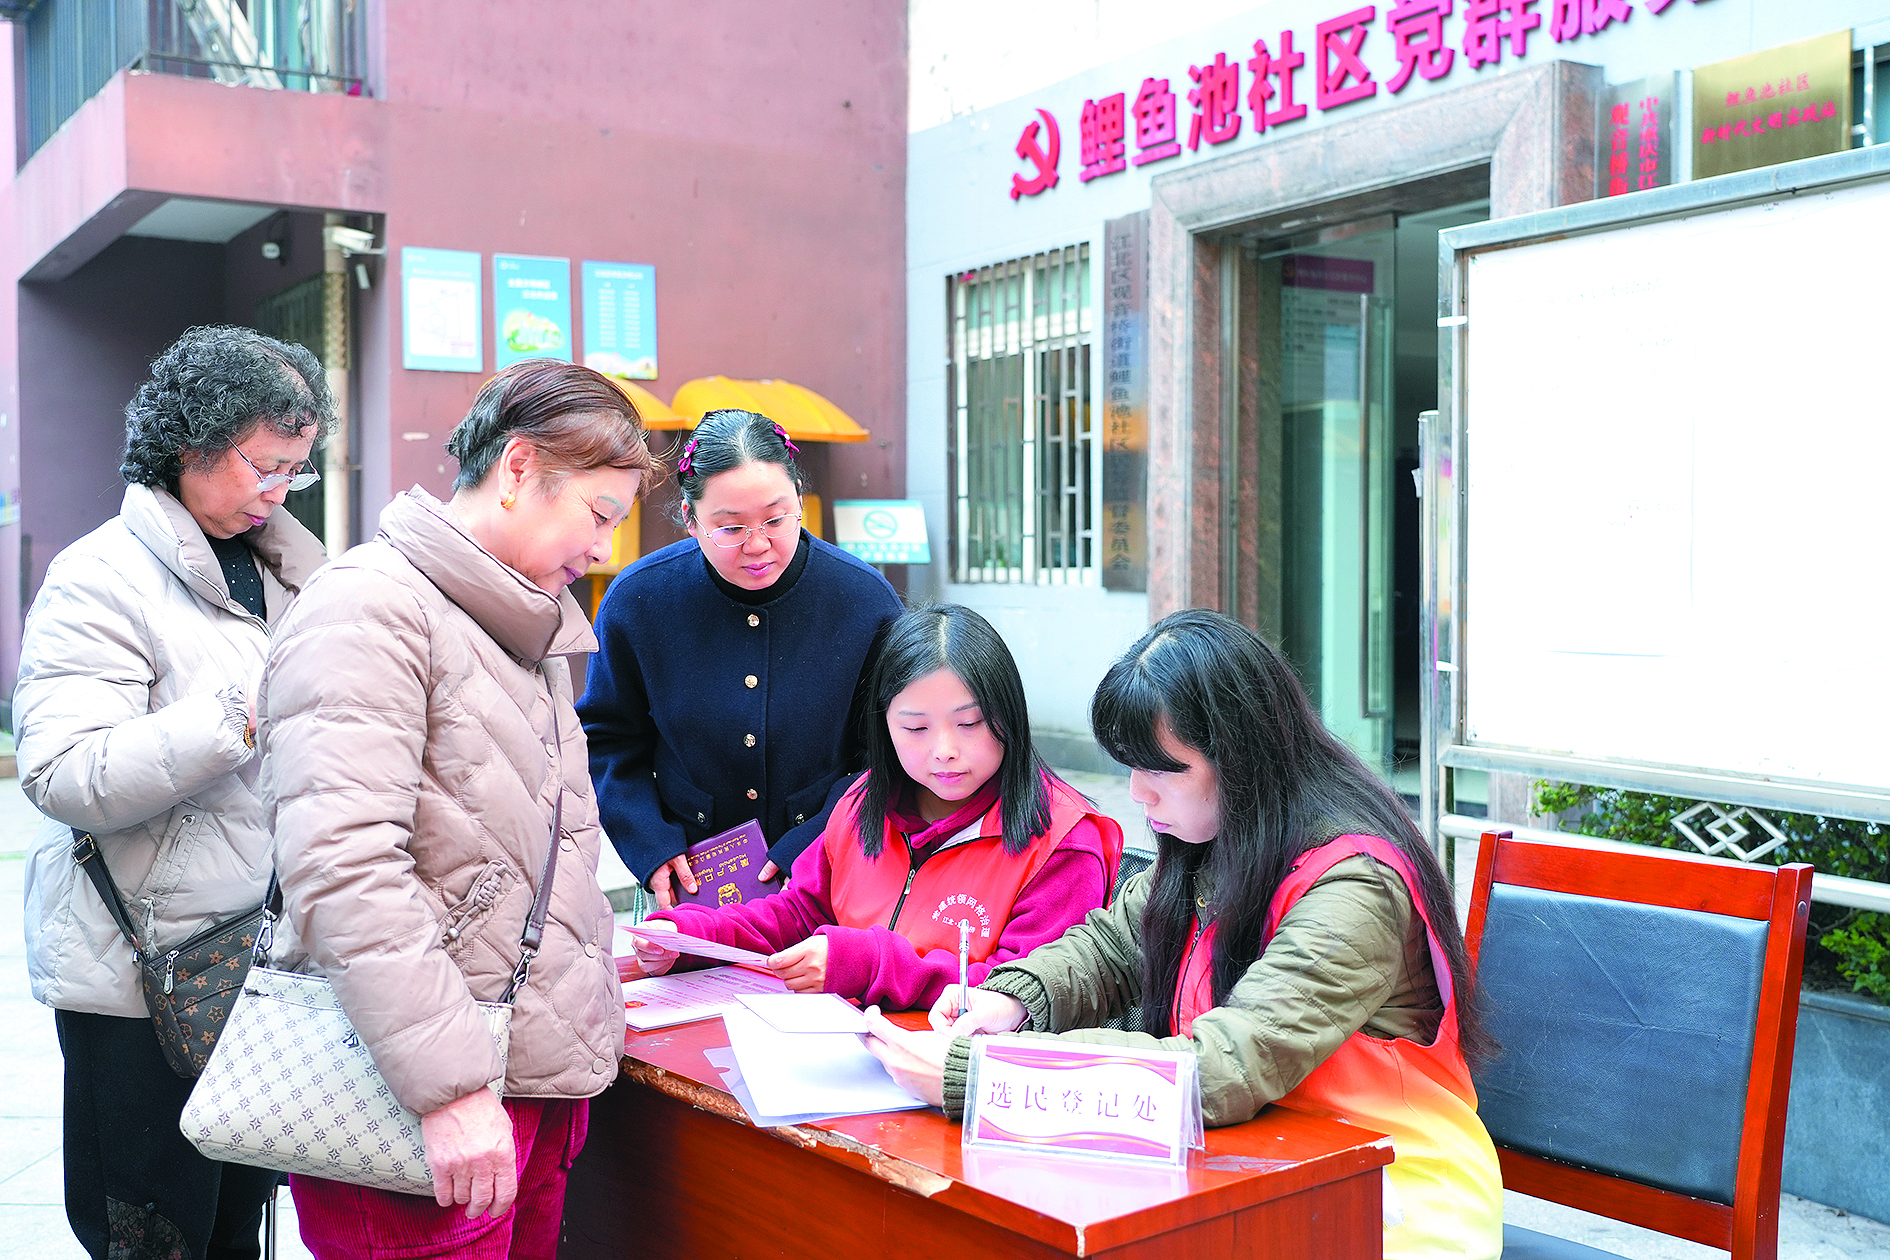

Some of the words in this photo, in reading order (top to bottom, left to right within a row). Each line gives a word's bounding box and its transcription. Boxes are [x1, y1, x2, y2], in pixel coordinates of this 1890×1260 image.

[1078, 0, 1712, 182] 鲤鱼池社区党群服
[1725, 72, 1811, 108] 鲤鱼池社区
[1701, 99, 1837, 145] 新时代文明实践站
[987, 1081, 1157, 1122] 选民登记处
